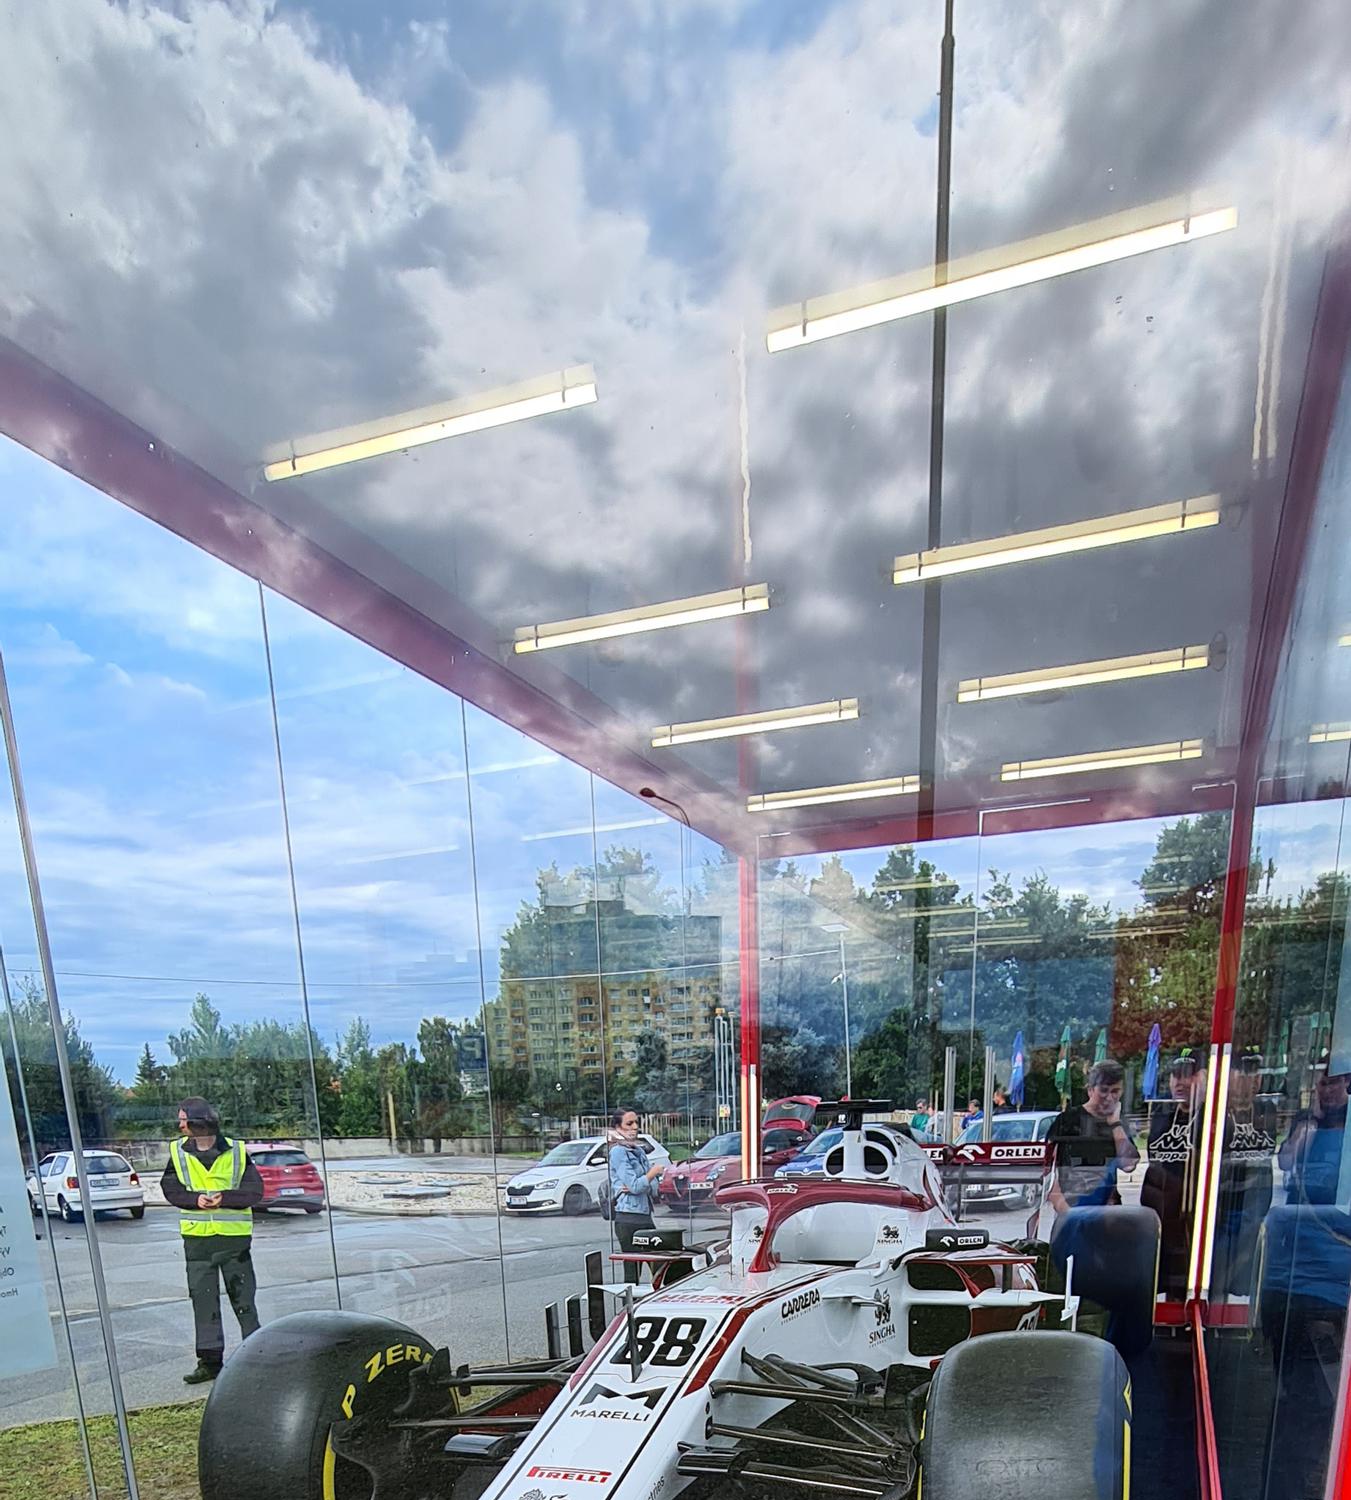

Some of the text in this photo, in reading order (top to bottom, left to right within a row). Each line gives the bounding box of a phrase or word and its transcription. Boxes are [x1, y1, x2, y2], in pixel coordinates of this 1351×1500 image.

[994, 1148, 1042, 1157] ORLEN
[959, 1236, 983, 1244] ORLEN
[781, 1288, 821, 1318] CARRERA
[610, 1316, 708, 1367] 88
[869, 1323, 896, 1344] SINGHA
[341, 1384, 356, 1419] P
[570, 1409, 650, 1422] MARELLI
[526, 1466, 613, 1484] PIRELLI
